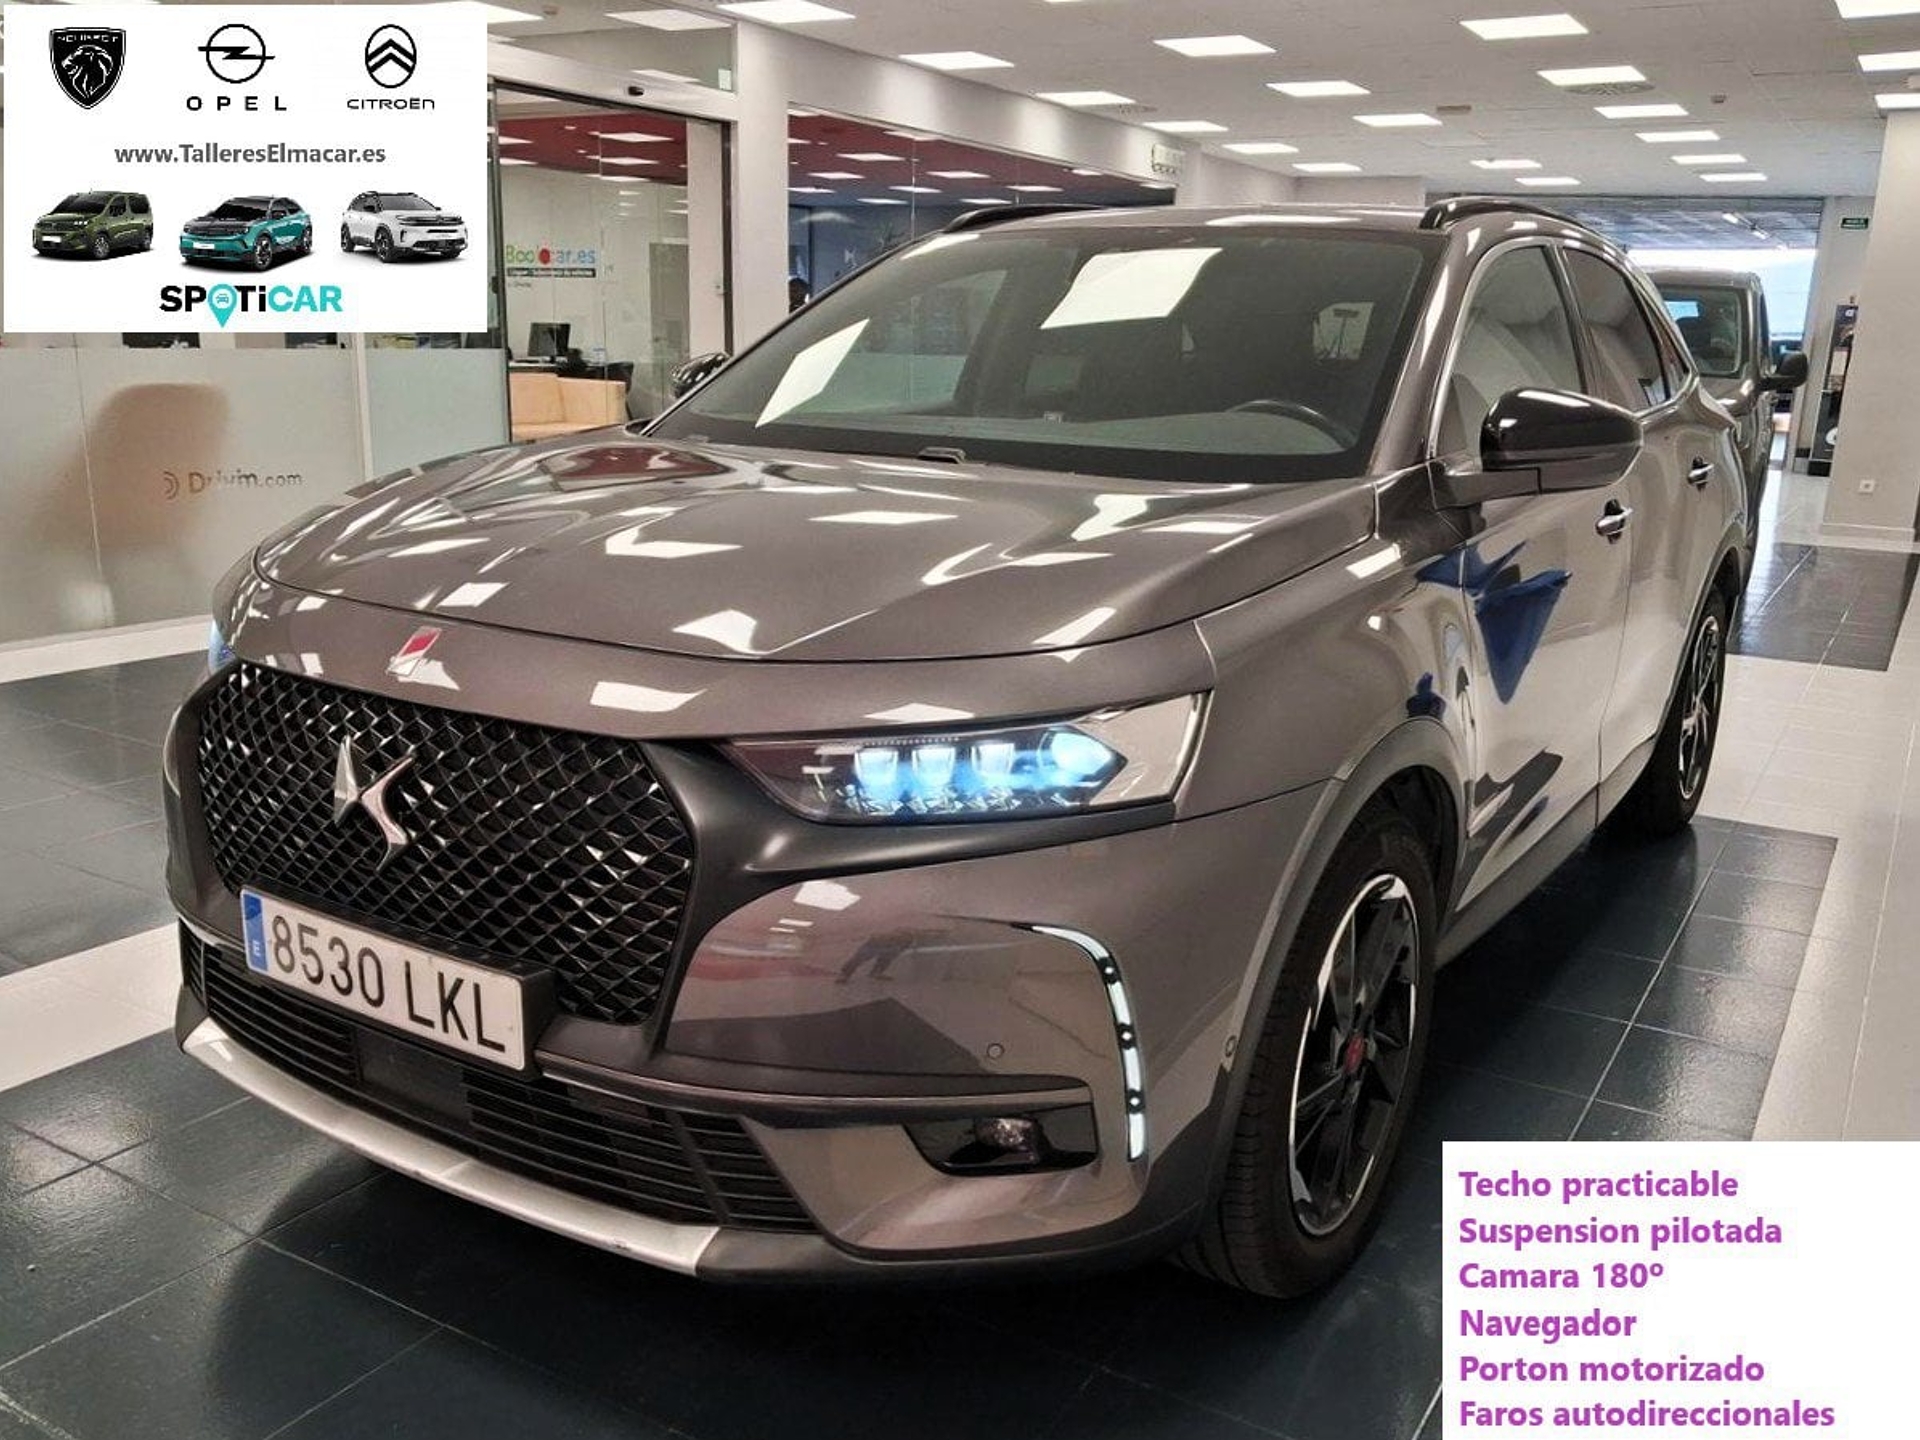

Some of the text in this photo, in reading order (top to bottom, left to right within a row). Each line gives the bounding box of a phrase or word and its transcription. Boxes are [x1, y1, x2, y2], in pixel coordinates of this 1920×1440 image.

[252, 939, 262, 957] E
[271, 914, 507, 1054] 8530 LKL
